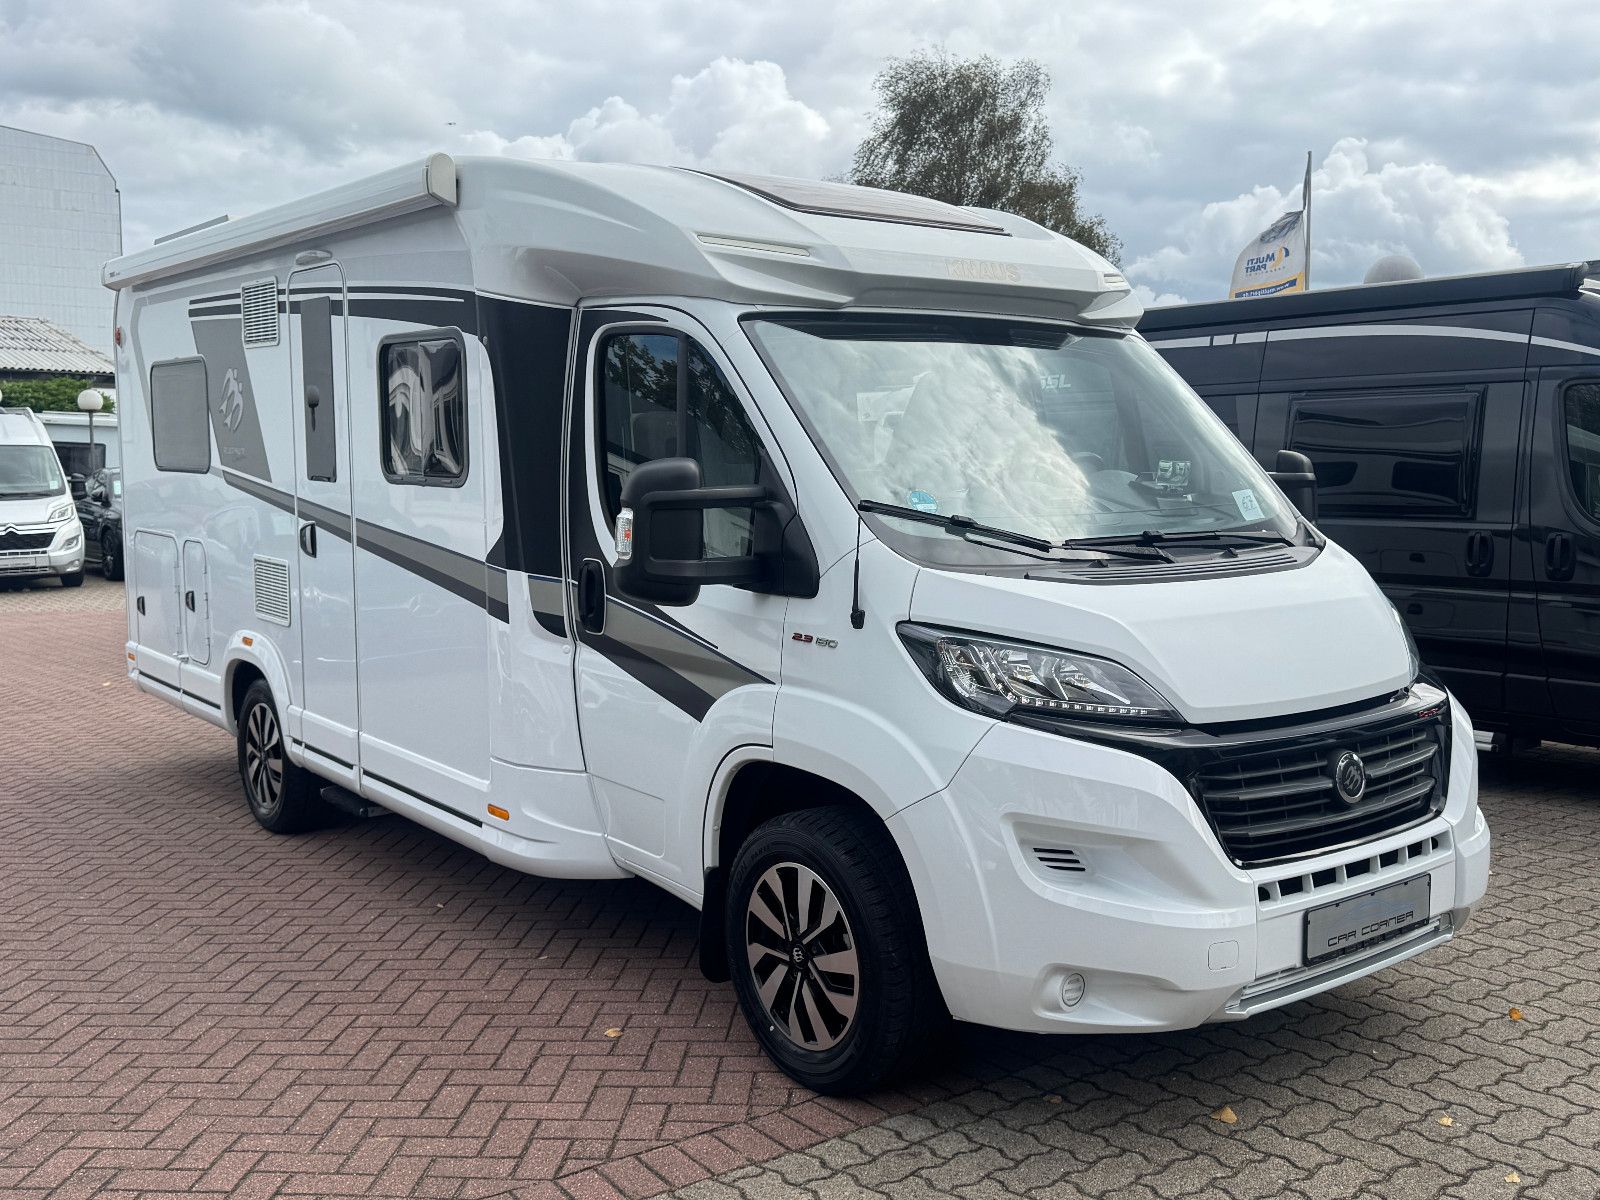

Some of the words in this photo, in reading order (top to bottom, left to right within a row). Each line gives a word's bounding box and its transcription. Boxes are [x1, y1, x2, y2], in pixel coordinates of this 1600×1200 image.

[944, 258, 1021, 282] KNAUS
[1328, 930, 1356, 947] CAR
[1361, 910, 1414, 936] CORNER
